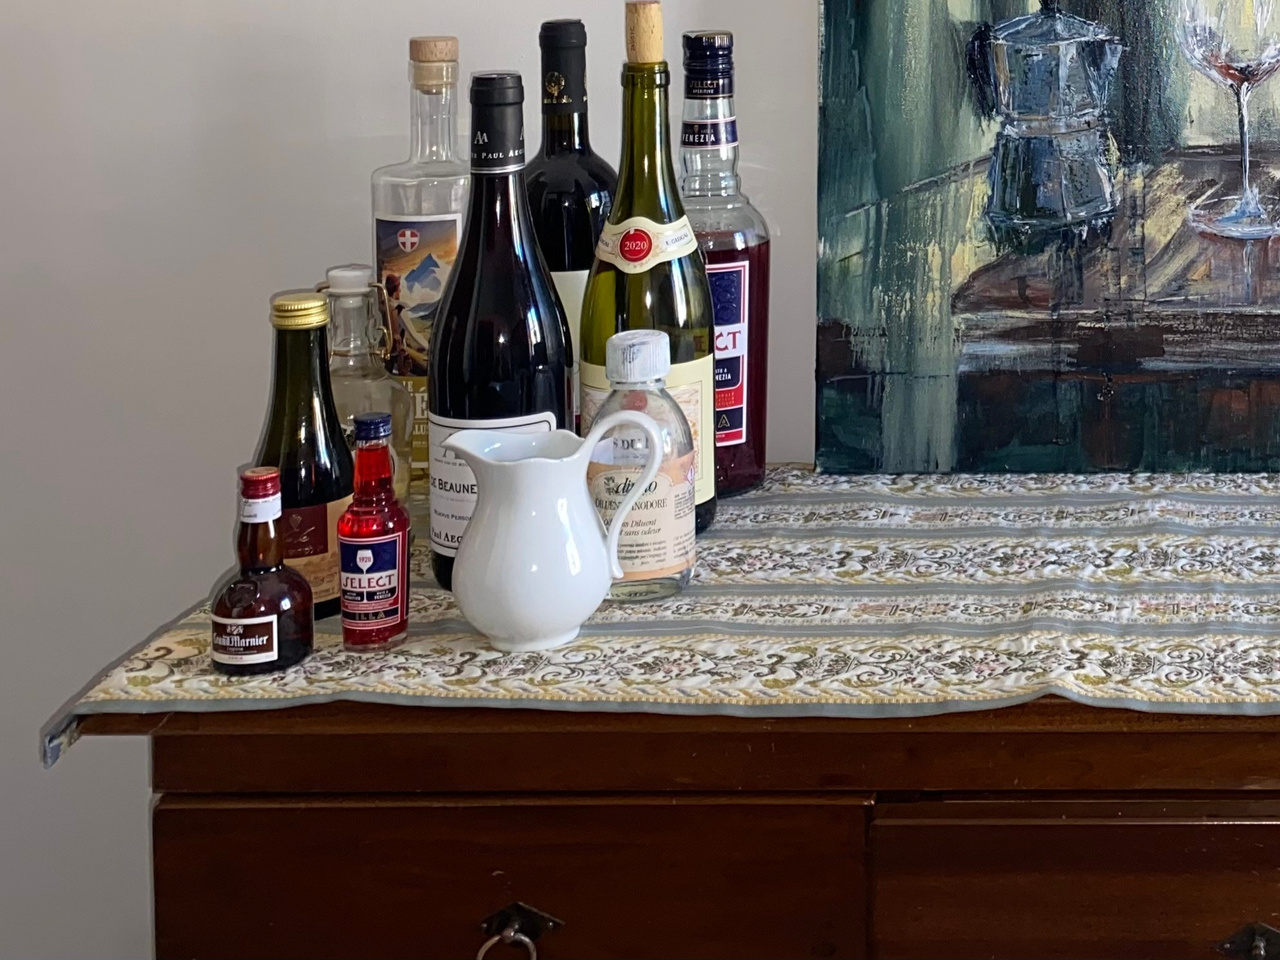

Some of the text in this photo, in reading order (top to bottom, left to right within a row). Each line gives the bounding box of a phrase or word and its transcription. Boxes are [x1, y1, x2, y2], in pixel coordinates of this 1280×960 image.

[682, 133, 716, 143] VENEZIA
[481, 151, 505, 159] PAUL
[508, 149, 524, 158] AEG
[624, 241, 647, 251] 2020
[715, 373, 732, 381] NEZIA
[438, 478, 478, 494] BEAUNE
[443, 532, 463, 544] AEG
[342, 573, 395, 590] SELECT
[229, 634, 270, 647] Marnier
